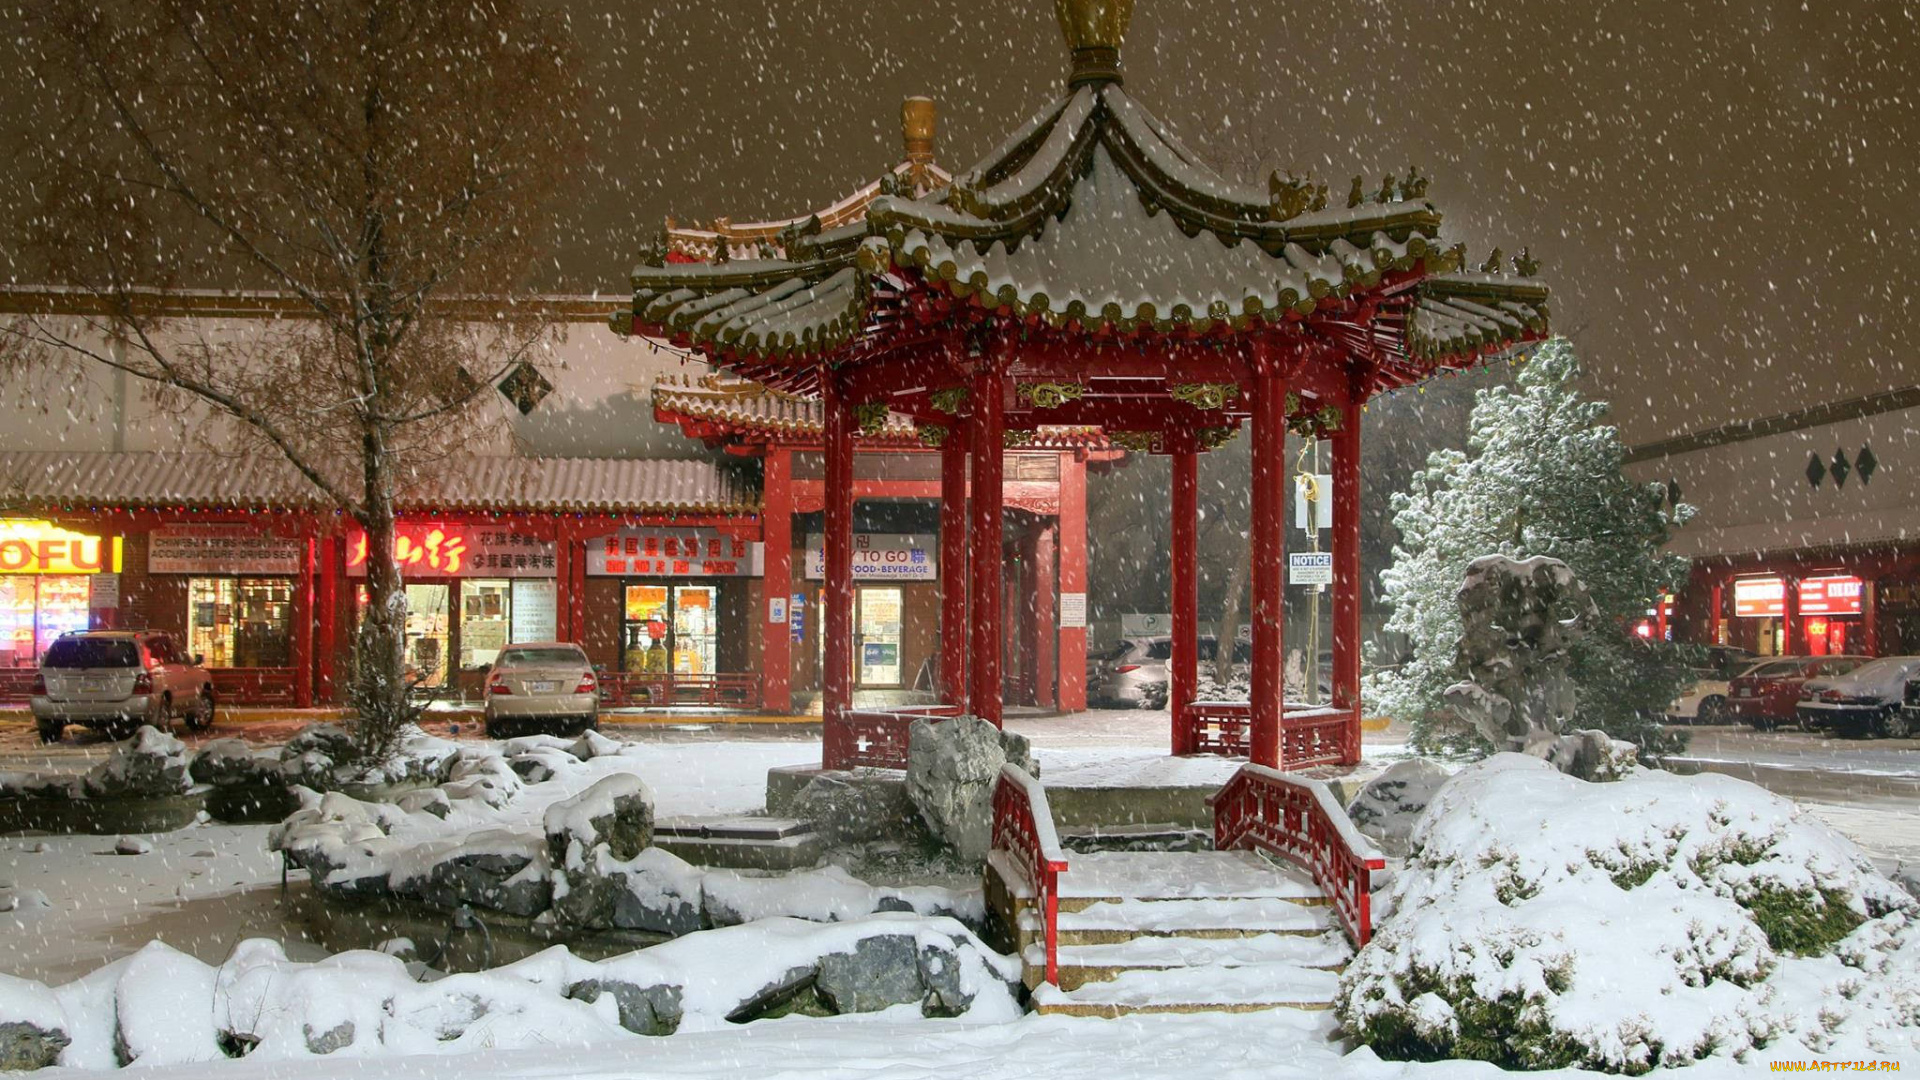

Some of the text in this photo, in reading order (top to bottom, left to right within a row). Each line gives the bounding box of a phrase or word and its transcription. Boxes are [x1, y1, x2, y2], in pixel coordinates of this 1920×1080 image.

[154, 538, 200, 547] CHINESE
[151, 549, 234, 559] ACCUPUNCTURE
[239, 549, 271, 559] DRIED
[860, 550, 881, 562] TO
[885, 550, 908, 562] GO
[1293, 555, 1330, 565] NOTICE
[881, 565, 928, 573] BEVERAGE
